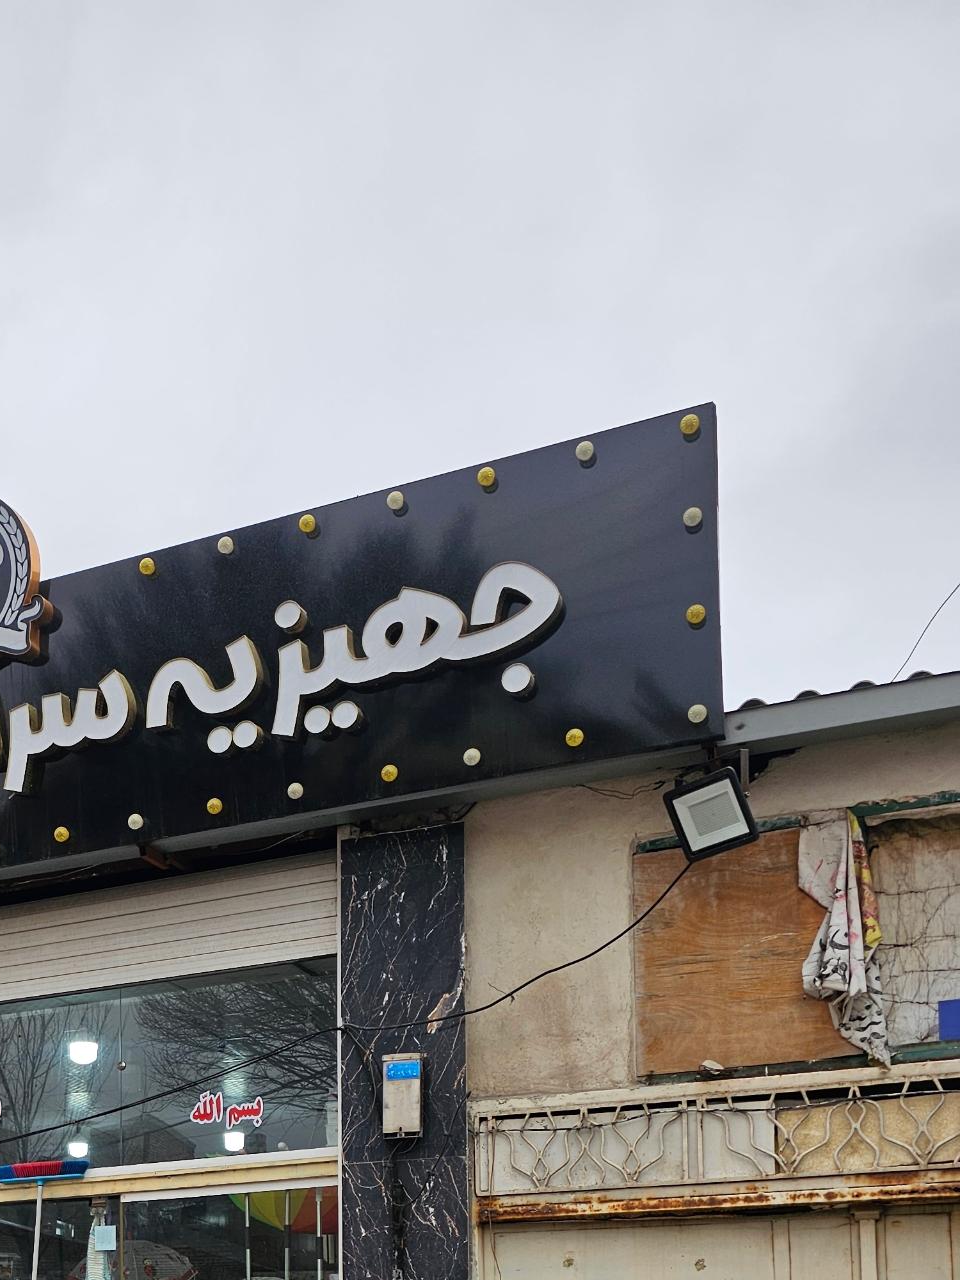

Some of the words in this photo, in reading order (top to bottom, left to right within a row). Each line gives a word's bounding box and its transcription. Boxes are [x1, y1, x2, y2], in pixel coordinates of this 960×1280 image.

[146, 560, 560, 754] جهیزیه
[190, 1091, 223, 1124] الله
[226, 1096, 264, 1130] بسم
